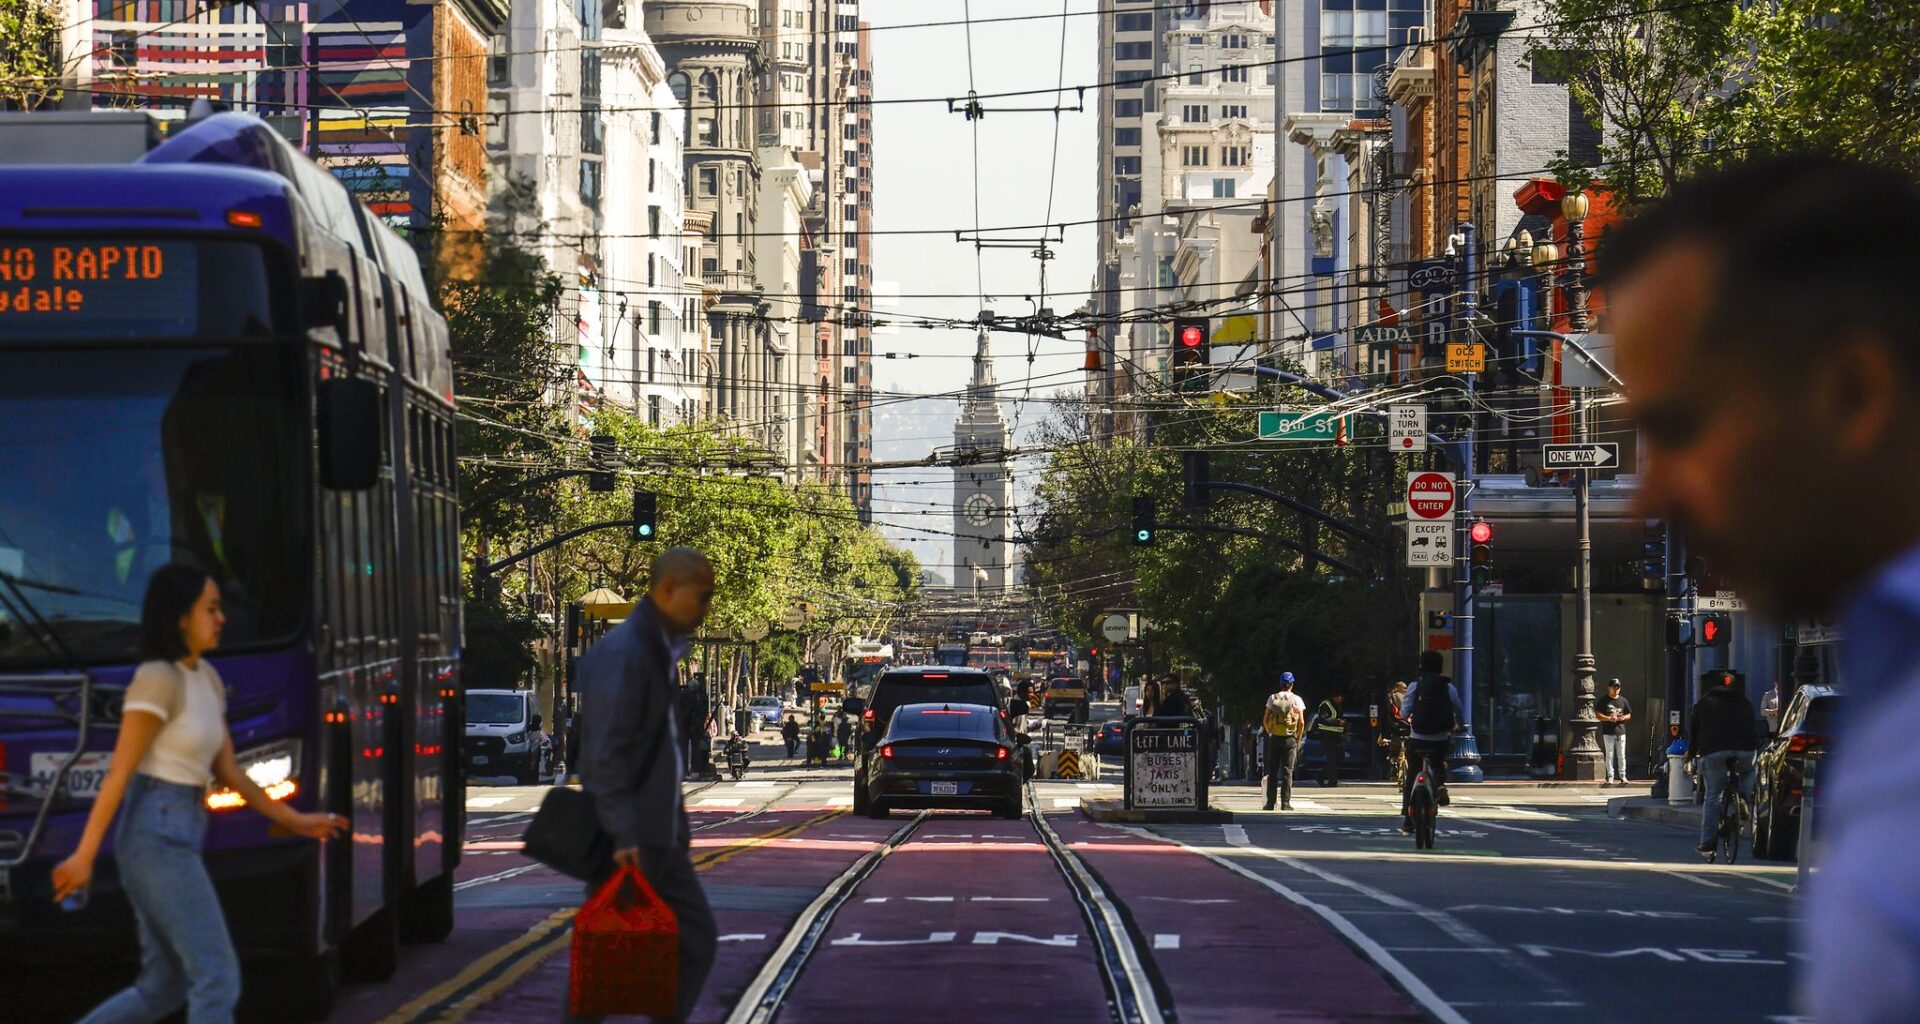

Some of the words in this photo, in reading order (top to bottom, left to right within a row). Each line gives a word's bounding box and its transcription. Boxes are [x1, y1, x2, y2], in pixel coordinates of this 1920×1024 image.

[53, 246, 163, 280] RAPID
[1360, 327, 1413, 343] AIDA
[1455, 347, 1475, 356] OCS
[1449, 359, 1481, 368] SWITCH
[1399, 409, 1416, 418] NO
[1279, 418, 1305, 433] 8th
[1315, 417, 1334, 433] St
[1397, 420, 1419, 428] TURN
[1392, 429, 1405, 438] ON
[1407, 429, 1423, 438] RED
[1550, 451, 1571, 462] ONE
[1574, 450, 1597, 461] WAY
[1415, 481, 1427, 490] DO
[1431, 481, 1448, 490] NOT
[1417, 502, 1444, 510] ENTER
[1415, 525, 1446, 534] EXCEPT
[1709, 600, 1724, 608] 8th
[1136, 735, 1160, 748] LEFT
[1167, 735, 1192, 748] LANE
[1147, 756, 1182, 766] BUSES
[1150, 770, 1180, 780] TAXIS
[1150, 784, 1178, 793] ONLY
[1137, 797, 1147, 805] AT
[1151, 797, 1165, 805] ALL
